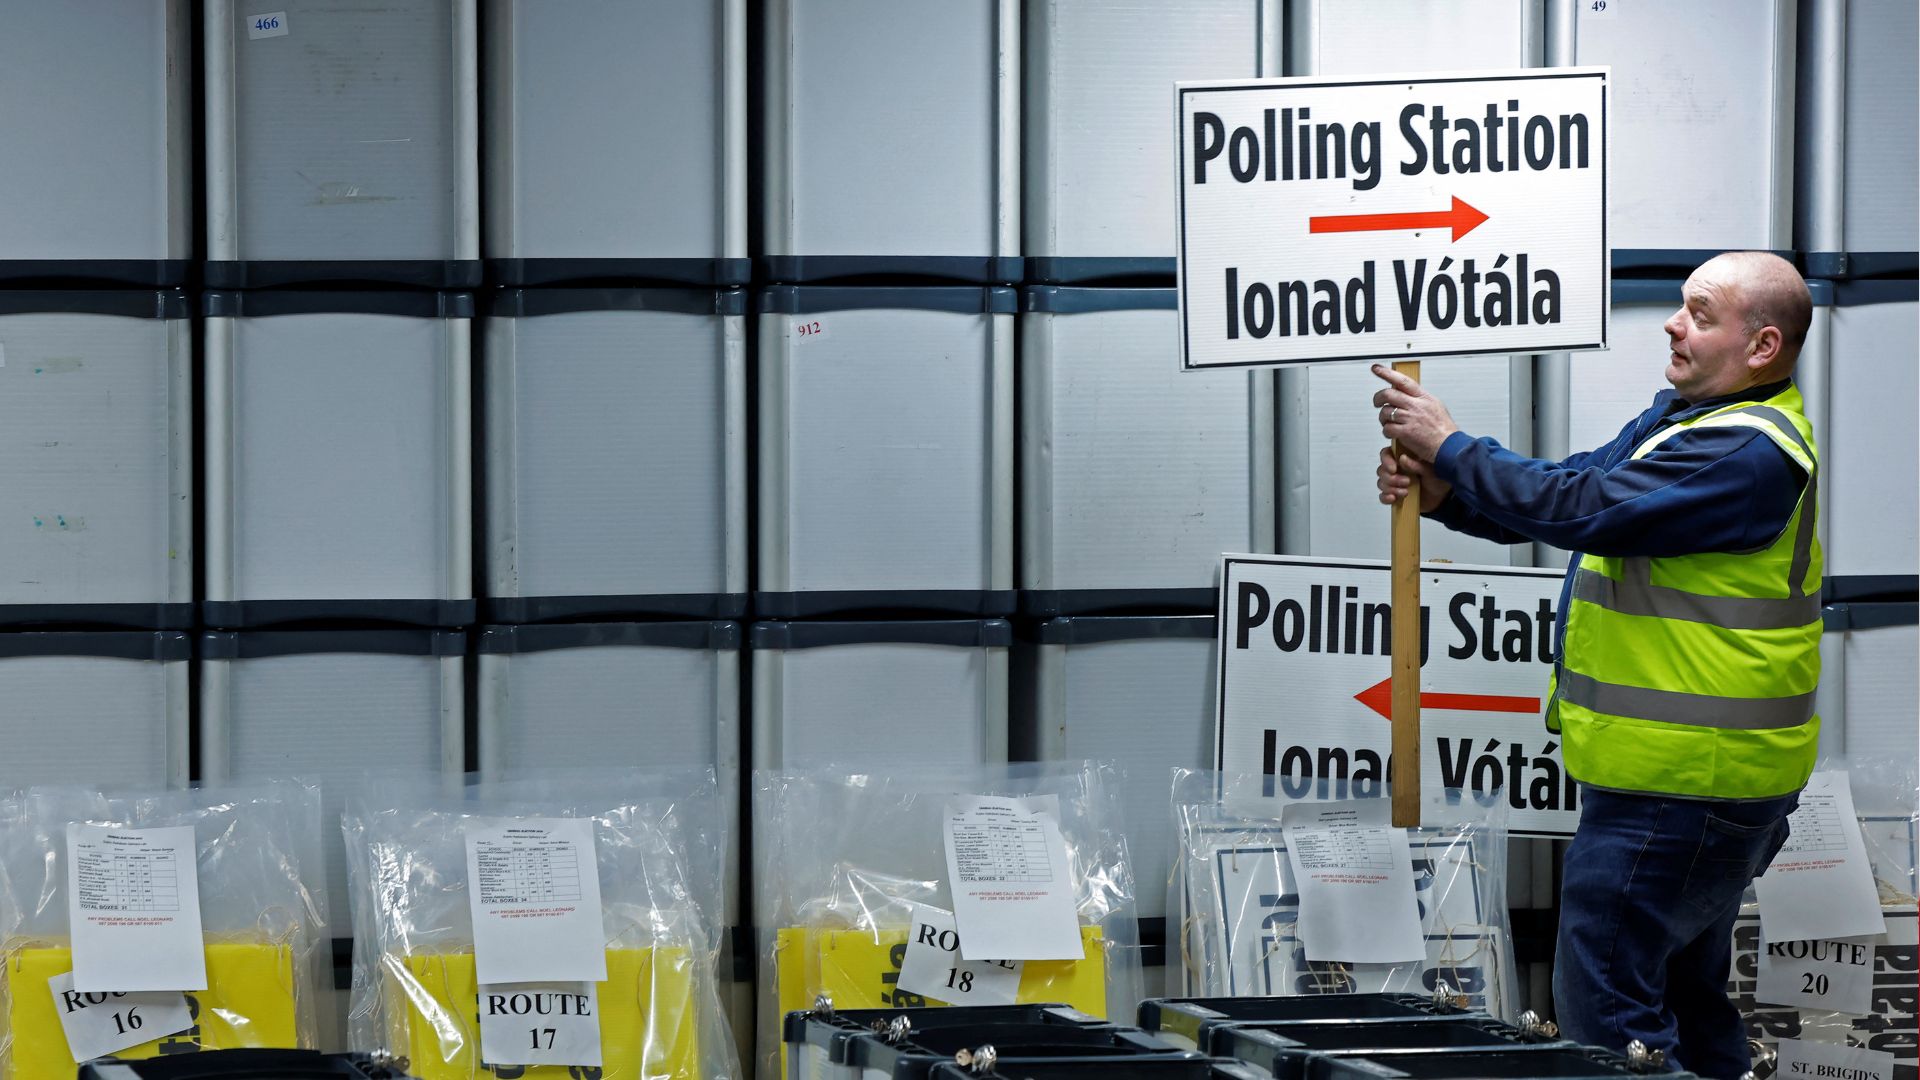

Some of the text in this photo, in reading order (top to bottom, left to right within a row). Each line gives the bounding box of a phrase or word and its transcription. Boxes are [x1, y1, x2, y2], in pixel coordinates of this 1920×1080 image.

[1591, 0, 1607, 12] 49
[255, 16, 279, 31] 466
[1193, 98, 1590, 191] Polling Station
[1225, 253, 1562, 341] Ionad Vótála
[797, 321, 821, 337] 912
[1448, 591, 1557, 664] Stat
[1262, 729, 1583, 811] Iona Vótál
[1767, 940, 1867, 966] ROUTE
[945, 967, 975, 993] 18
[1800, 972, 1829, 996] 20
[487, 993, 591, 1017] ROUTE
[111, 1006, 143, 1035] 16
[529, 1028, 557, 1050] 17
[1791, 1061, 1880, 1080] ST. BRIGID'S
